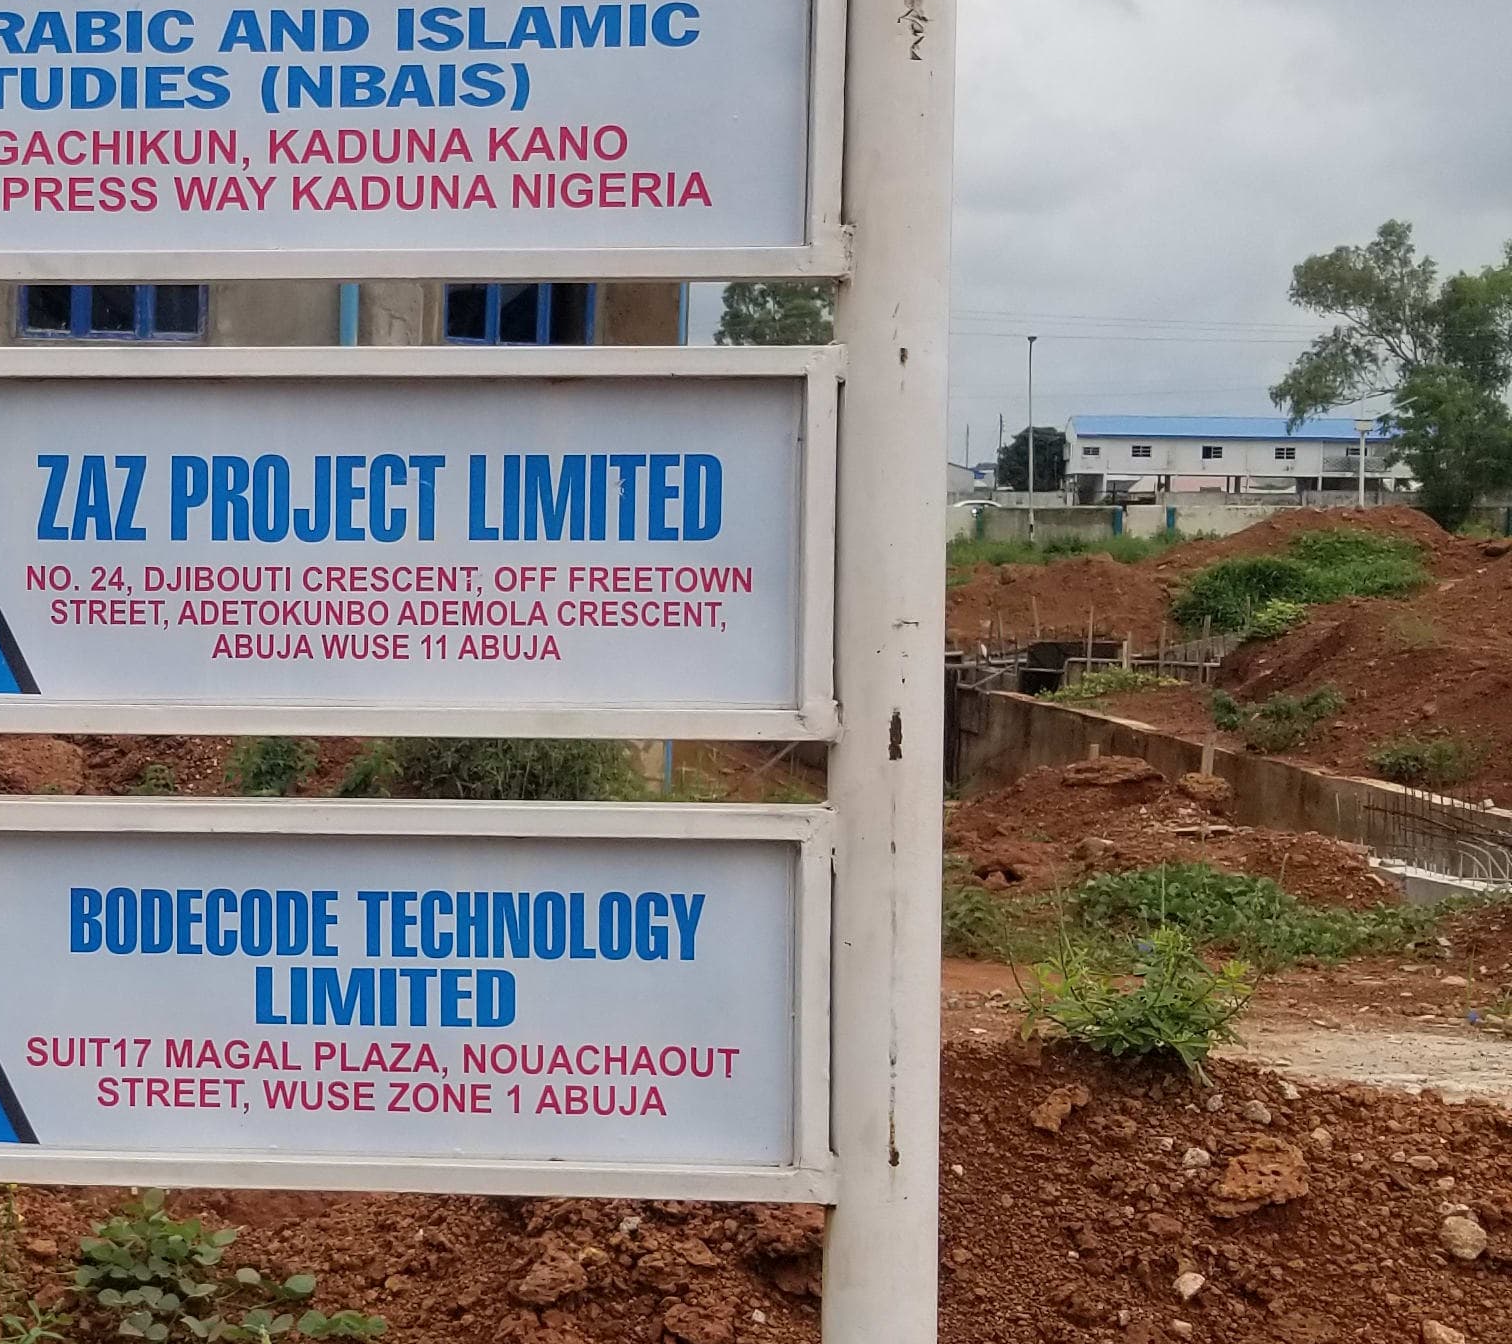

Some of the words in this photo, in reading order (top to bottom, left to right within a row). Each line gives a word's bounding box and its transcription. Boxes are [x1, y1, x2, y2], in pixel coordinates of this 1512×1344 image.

[219, 9, 369, 52] AND
[398, 2, 699, 51] ISLAMIC
[262, 63, 529, 113] (NBAIS)
[270, 128, 472, 163] KADUNA
[489, 125, 627, 161] KANO
[174, 177, 275, 210] WAY
[293, 175, 496, 210] KADUNA
[513, 172, 711, 208] NIGERIA
[38, 455, 146, 540] ZAZ
[171, 454, 445, 542] PROJECT
[469, 454, 722, 541] LIMITED
[27, 566, 78, 591] NO.
[91, 567, 132, 596] 24,
[145, 567, 290, 591] DJIBOUTI
[303, 567, 482, 597] CRESCENT,
[495, 567, 556, 592] OFF
[570, 567, 751, 592] FREETOWN
[52, 600, 169, 630] STREET,
[178, 601, 388, 625] ADETOKUNBO
[398, 601, 548, 626] ADEMOLA
[558, 601, 726, 631] CRESCENT,
[212, 634, 313, 659] ABUJA
[322, 634, 409, 659] WUSE
[420, 635, 446, 659] 11
[459, 635, 560, 660] ABUJA
[71, 888, 338, 956] BODECODE
[358, 891, 705, 960] TECHNOLOGY
[256, 967, 515, 1027] LIMITED
[27, 1037, 151, 1067] SUIT17
[166, 1039, 301, 1070] MAGAL
[315, 1042, 448, 1079] PLAZA,
[464, 1044, 739, 1078] NOUACHAOUT
[98, 1078, 249, 1113] STREET,
[264, 1080, 375, 1110] WUSE
[388, 1083, 491, 1113] ZONE
[508, 1085, 519, 1113] 1
[536, 1085, 666, 1115] ABUJA
